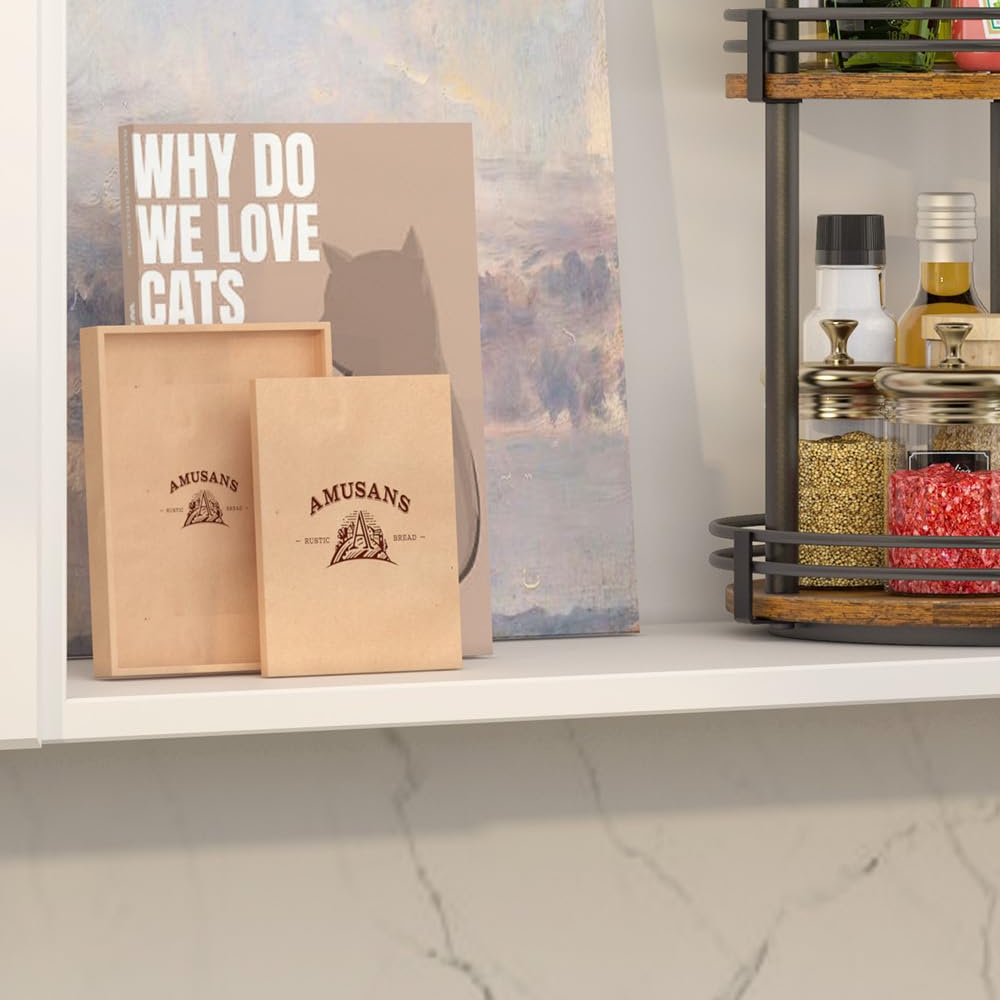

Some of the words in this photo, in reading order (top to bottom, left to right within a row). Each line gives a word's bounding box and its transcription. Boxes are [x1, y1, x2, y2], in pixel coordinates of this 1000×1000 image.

[132, 132, 237, 199] WHY
[253, 132, 316, 198] DO
[136, 203, 204, 265] WE
[217, 202, 321, 264] LOVE
[141, 268, 245, 326] CATS
[169, 470, 239, 494] AMUSANS
[310, 481, 411, 516] AMUSANS
[304, 537, 331, 545] RUSTIC
[392, 534, 417, 542] BREAD
